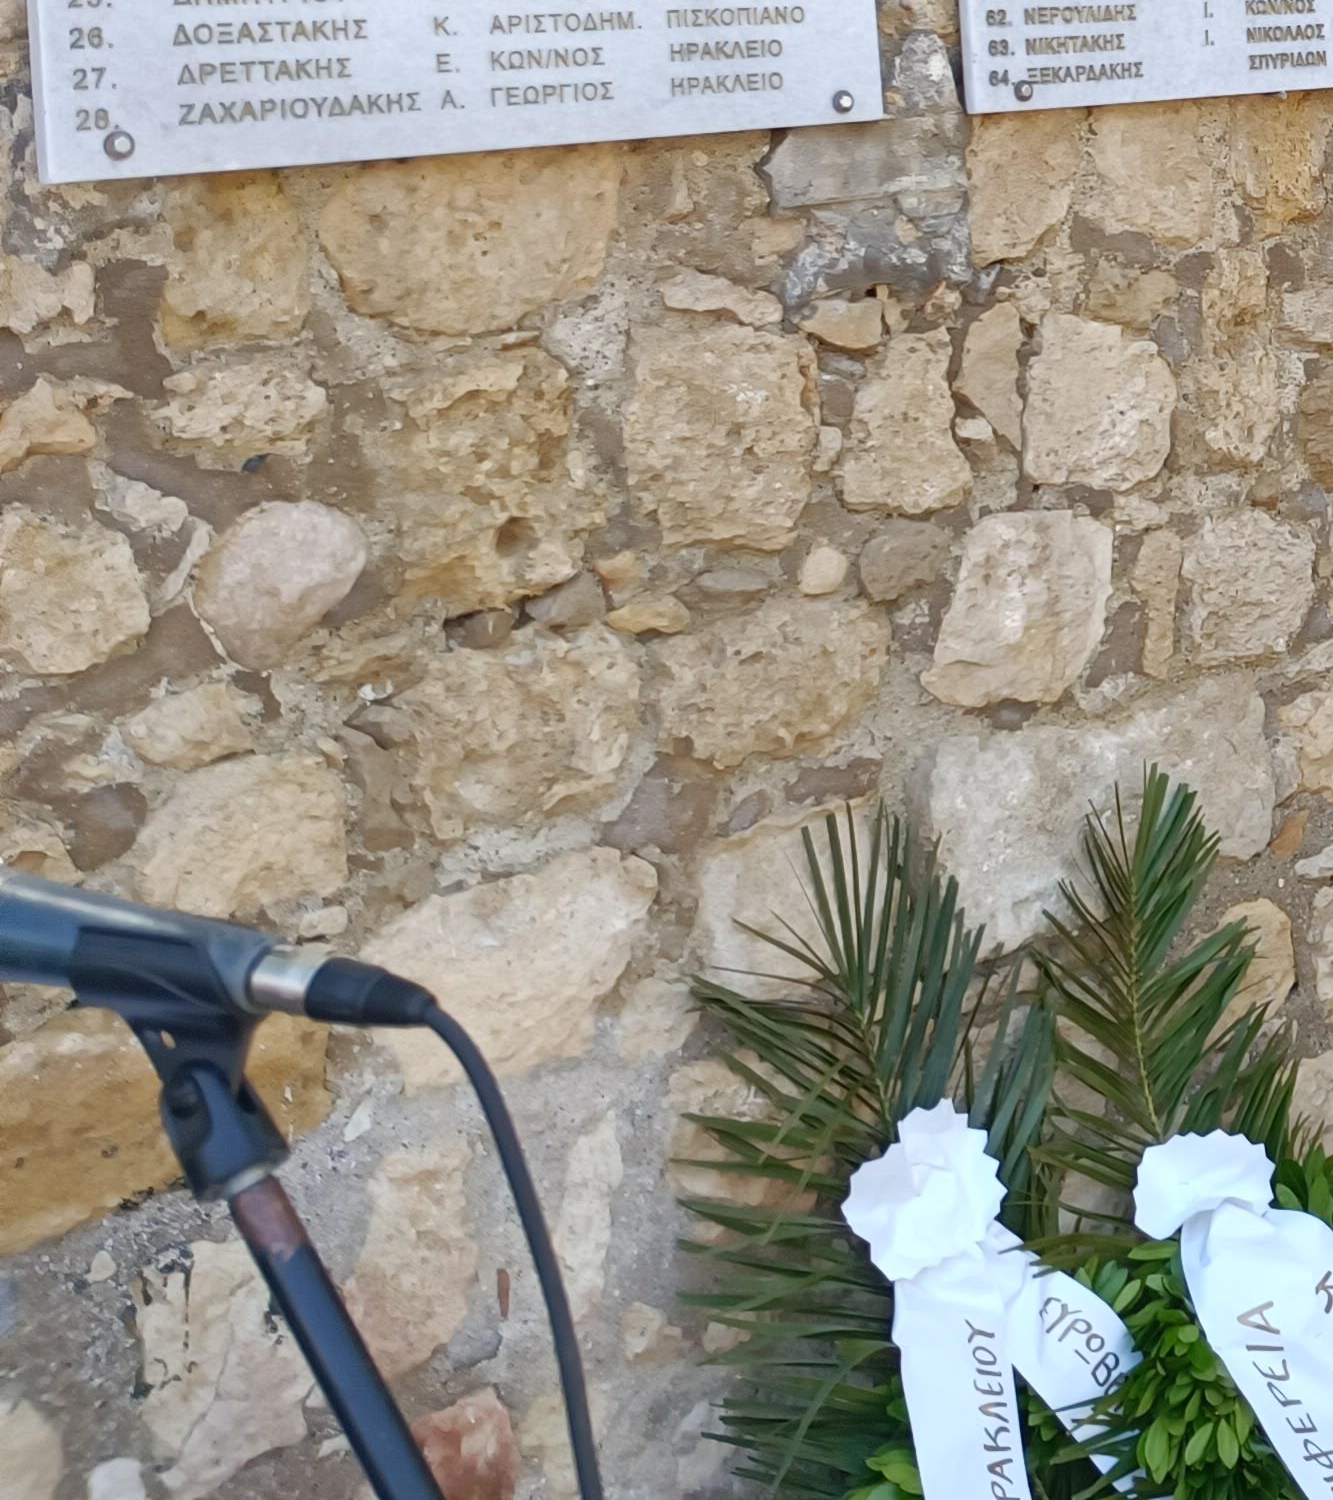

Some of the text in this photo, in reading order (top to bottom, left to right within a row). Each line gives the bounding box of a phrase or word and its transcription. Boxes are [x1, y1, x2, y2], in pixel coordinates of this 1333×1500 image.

[171, 5, 806, 47] ΔΟΞΑΣΤΑΚΗΣ ΠΙΣΚΟΠΙΑΝΟ
[176, 56, 353, 86] ΔΡΕΤΤΑΚΗΣ
[178, 90, 423, 127] ΖΑΧΑΡΙΟΥΔΑΚΗΣ
